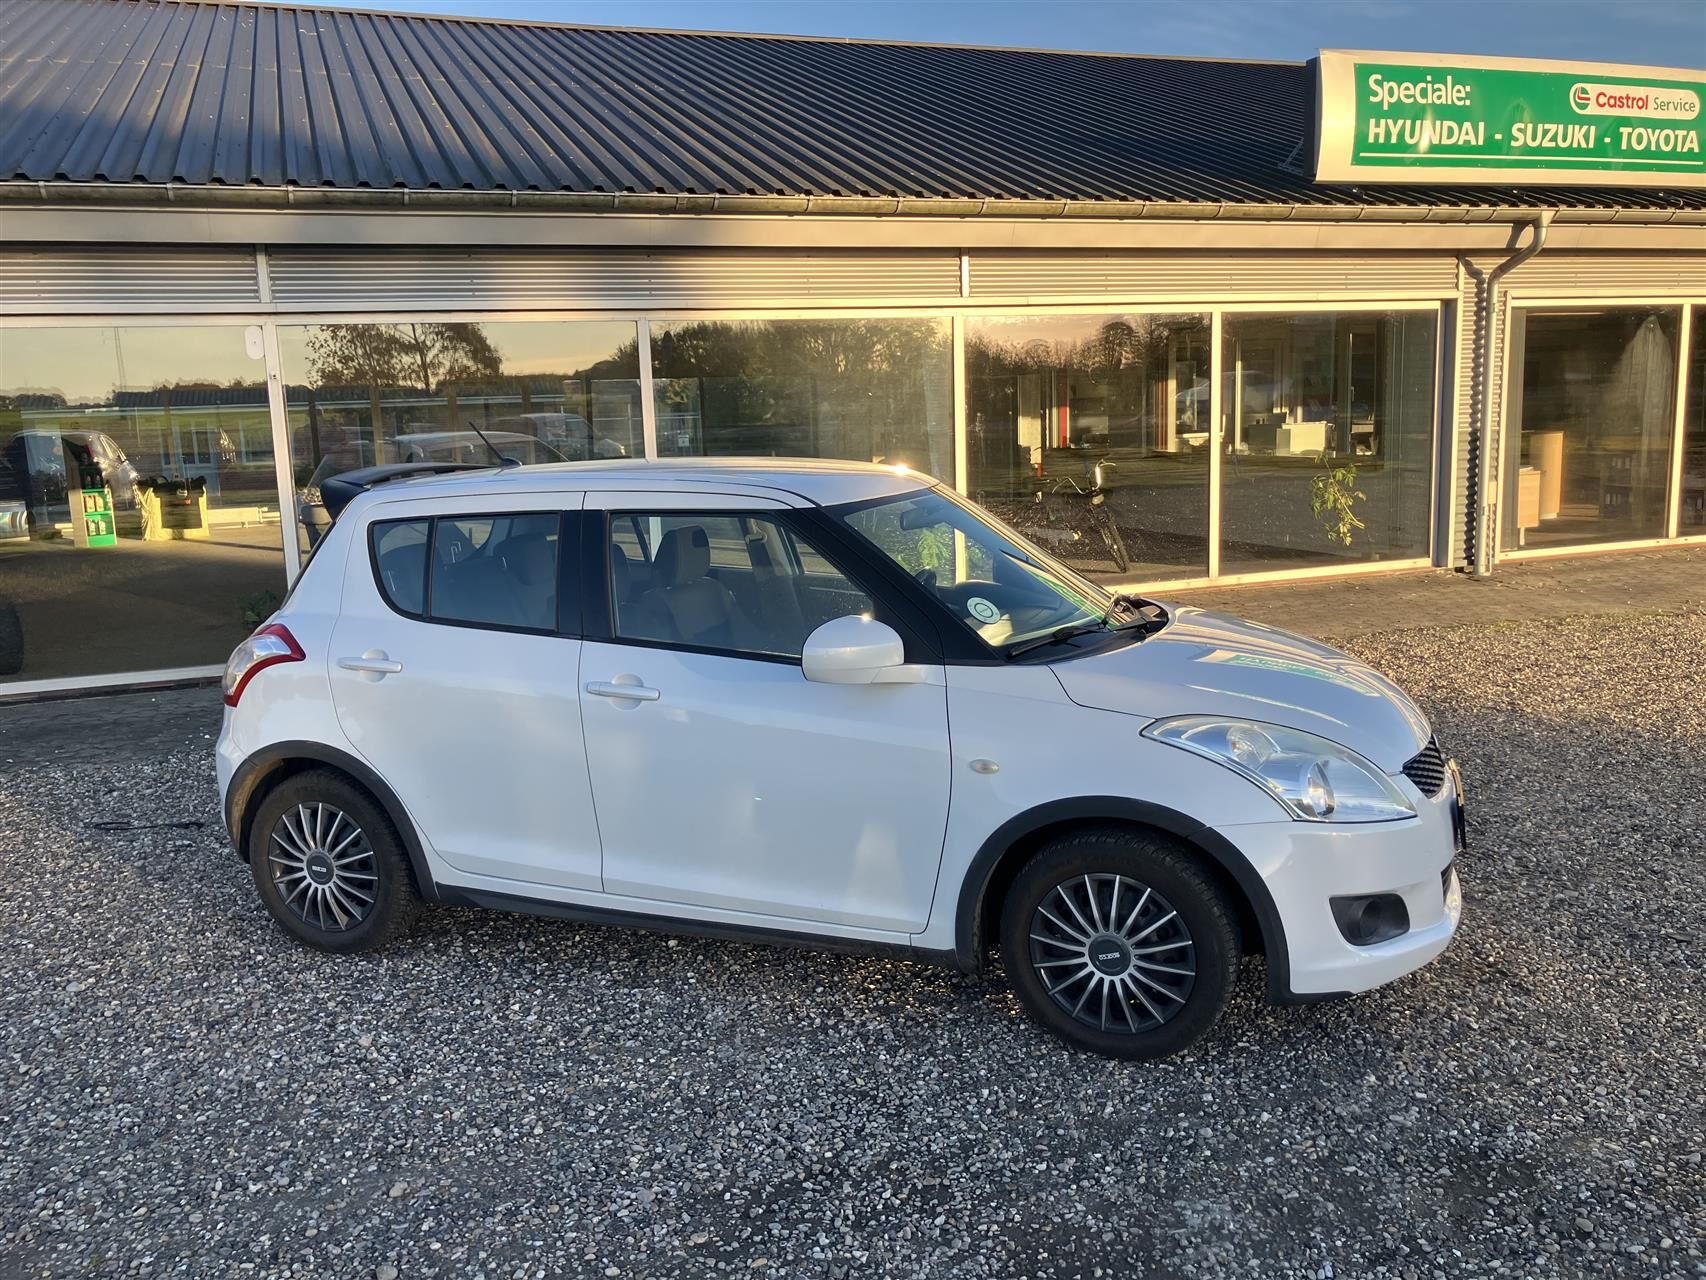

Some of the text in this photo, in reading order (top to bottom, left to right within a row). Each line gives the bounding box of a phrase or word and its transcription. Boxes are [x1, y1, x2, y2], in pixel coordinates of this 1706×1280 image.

[1368, 73, 1471, 111] Speciale:
[1595, 91, 1696, 112] Castrol Service
[1367, 118, 1485, 146] HYUNDAI
[1510, 122, 1596, 149] SUZUKI
[1619, 126, 1700, 153] TOYOTA
